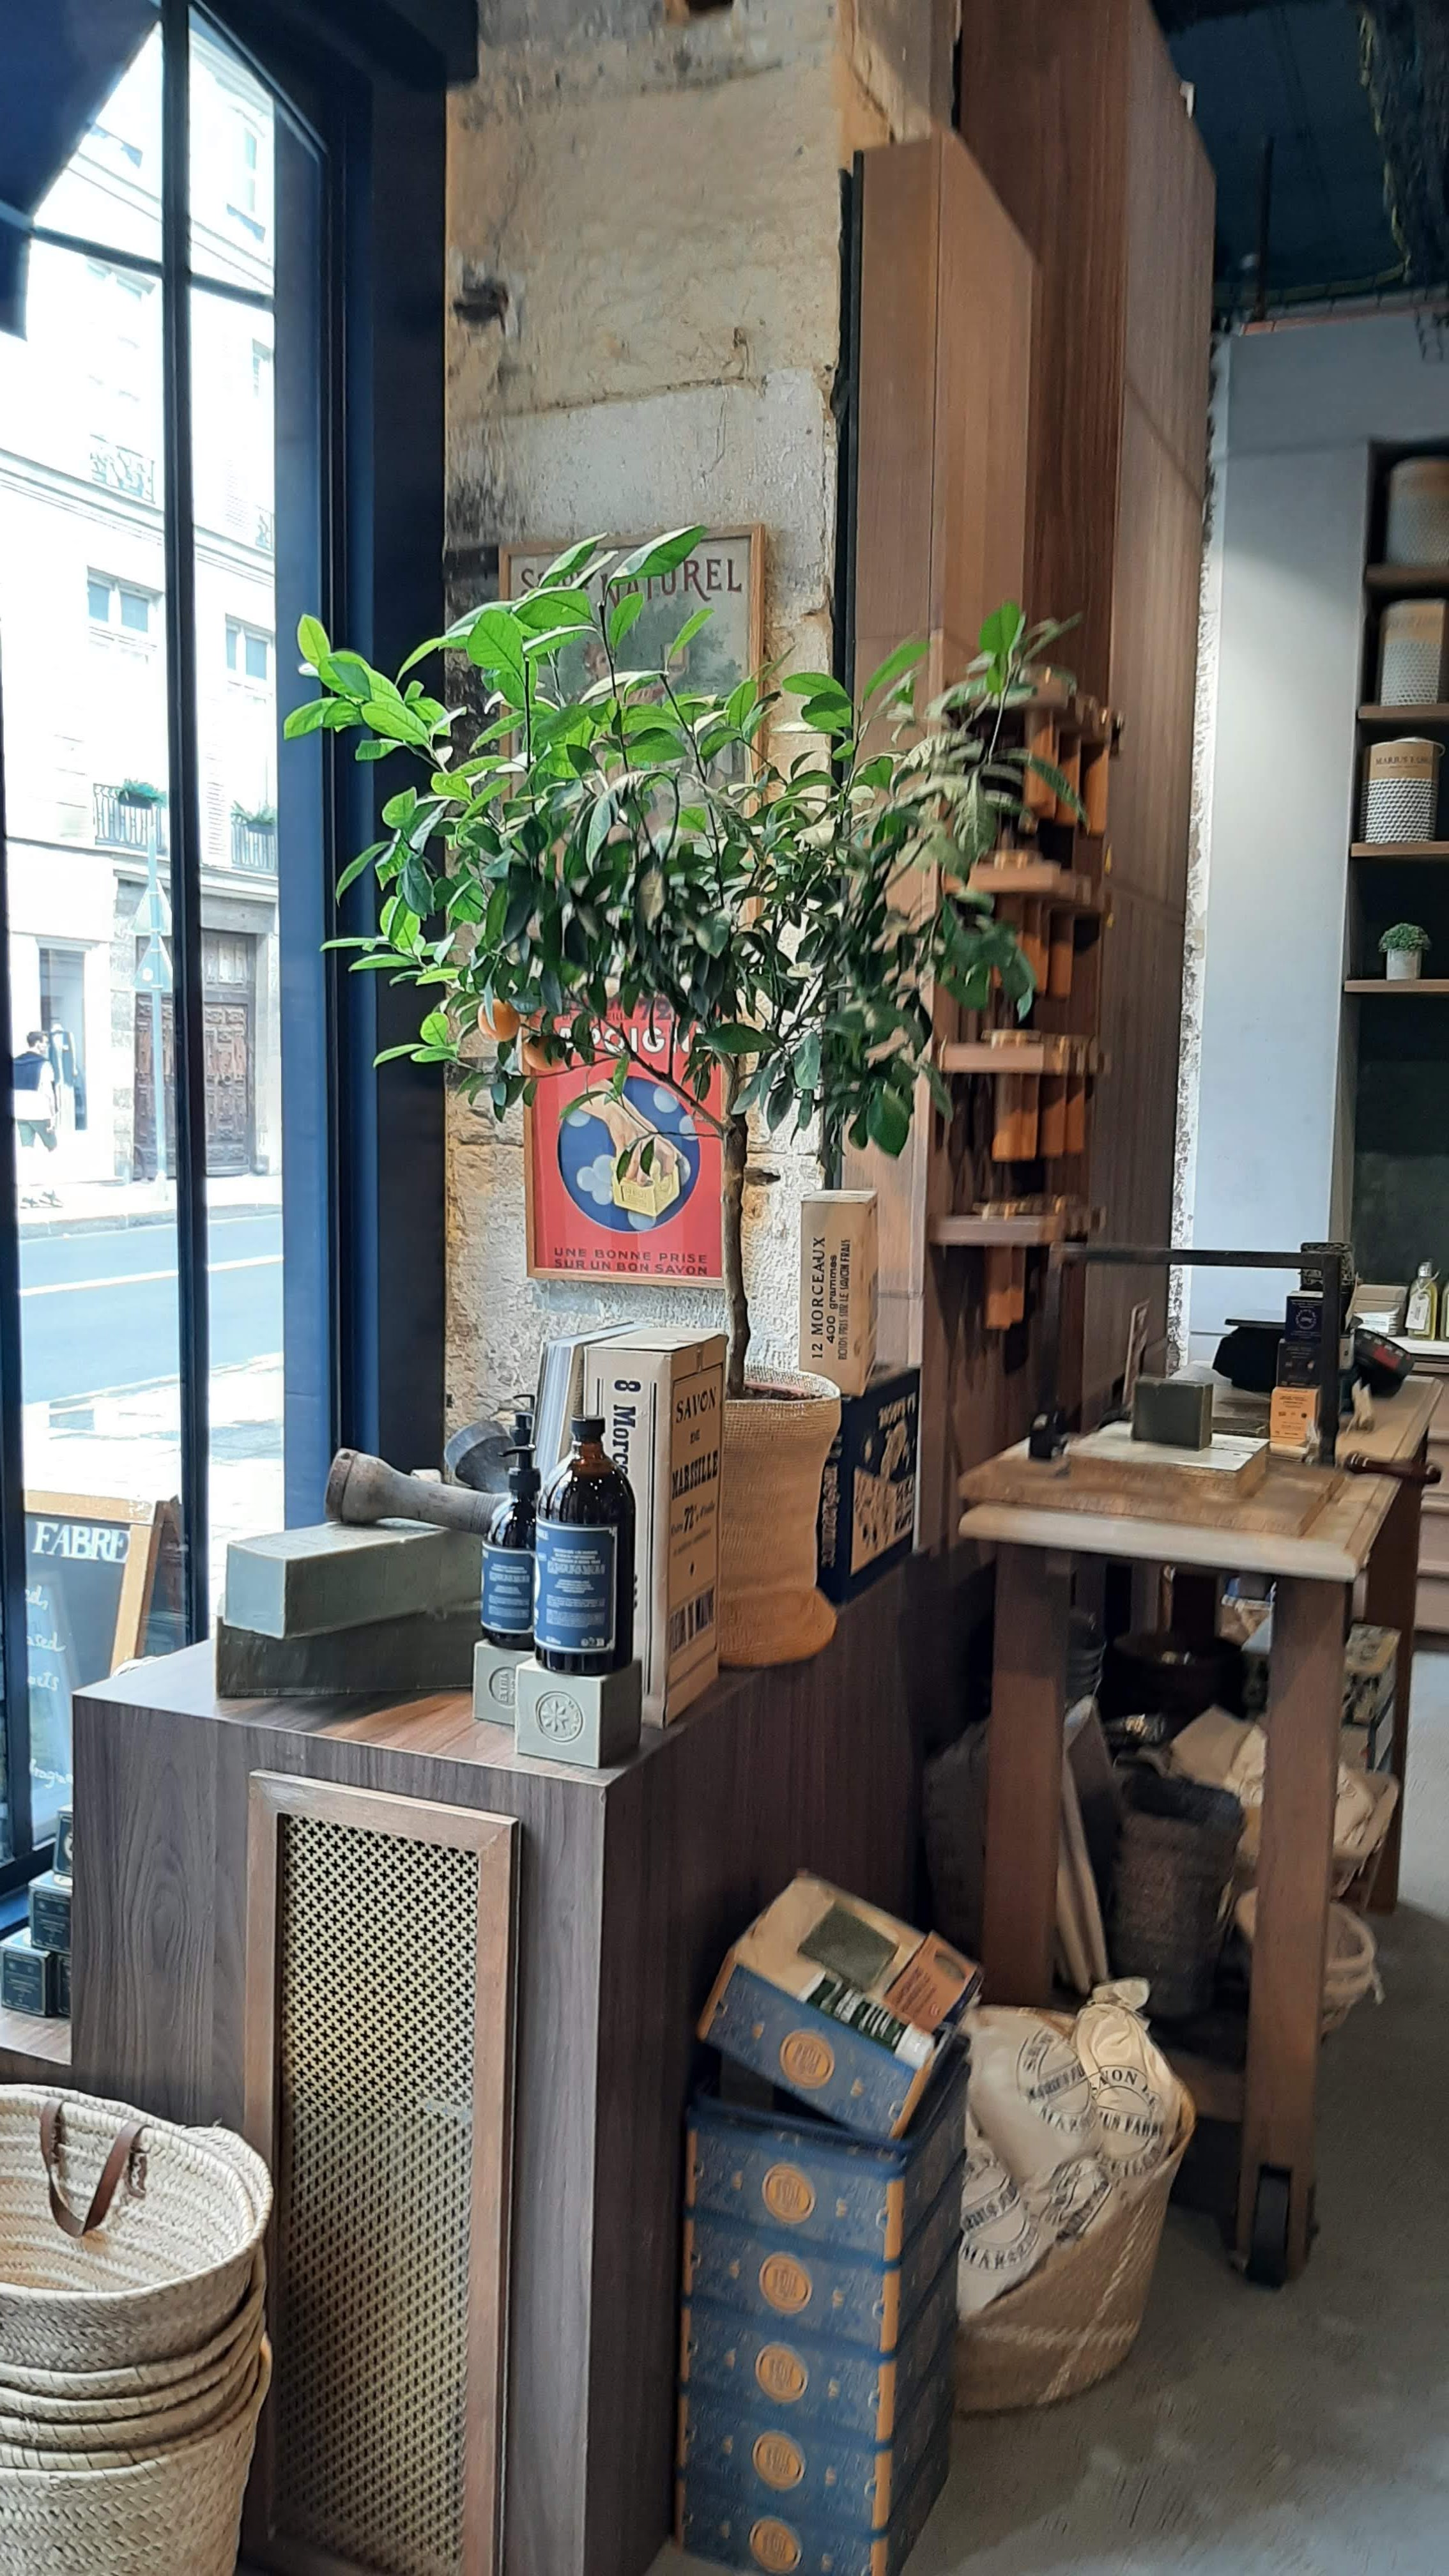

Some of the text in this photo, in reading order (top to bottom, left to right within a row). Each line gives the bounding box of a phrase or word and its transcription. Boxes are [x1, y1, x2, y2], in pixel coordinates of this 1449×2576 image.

[589, 1026, 714, 1054] POIGN
[554, 1247, 707, 1264] UNE BONNE PRISE
[841, 1239, 850, 1262] FRAIS
[554, 1259, 708, 1276] SUR UN BON SAVON
[840, 1264, 850, 1290] SAVON
[811, 1236, 825, 1360] 12 MORCEAUX
[826, 1254, 839, 1344] 400 grammes
[839, 1292, 849, 1303] LE
[614, 1379, 641, 1393] 8
[676, 1386, 717, 1424] SAVON
[690, 1429, 701, 1445] DE
[672, 1450, 719, 1501] MARSEILLE
[31, 1521, 131, 1564] FABRE
